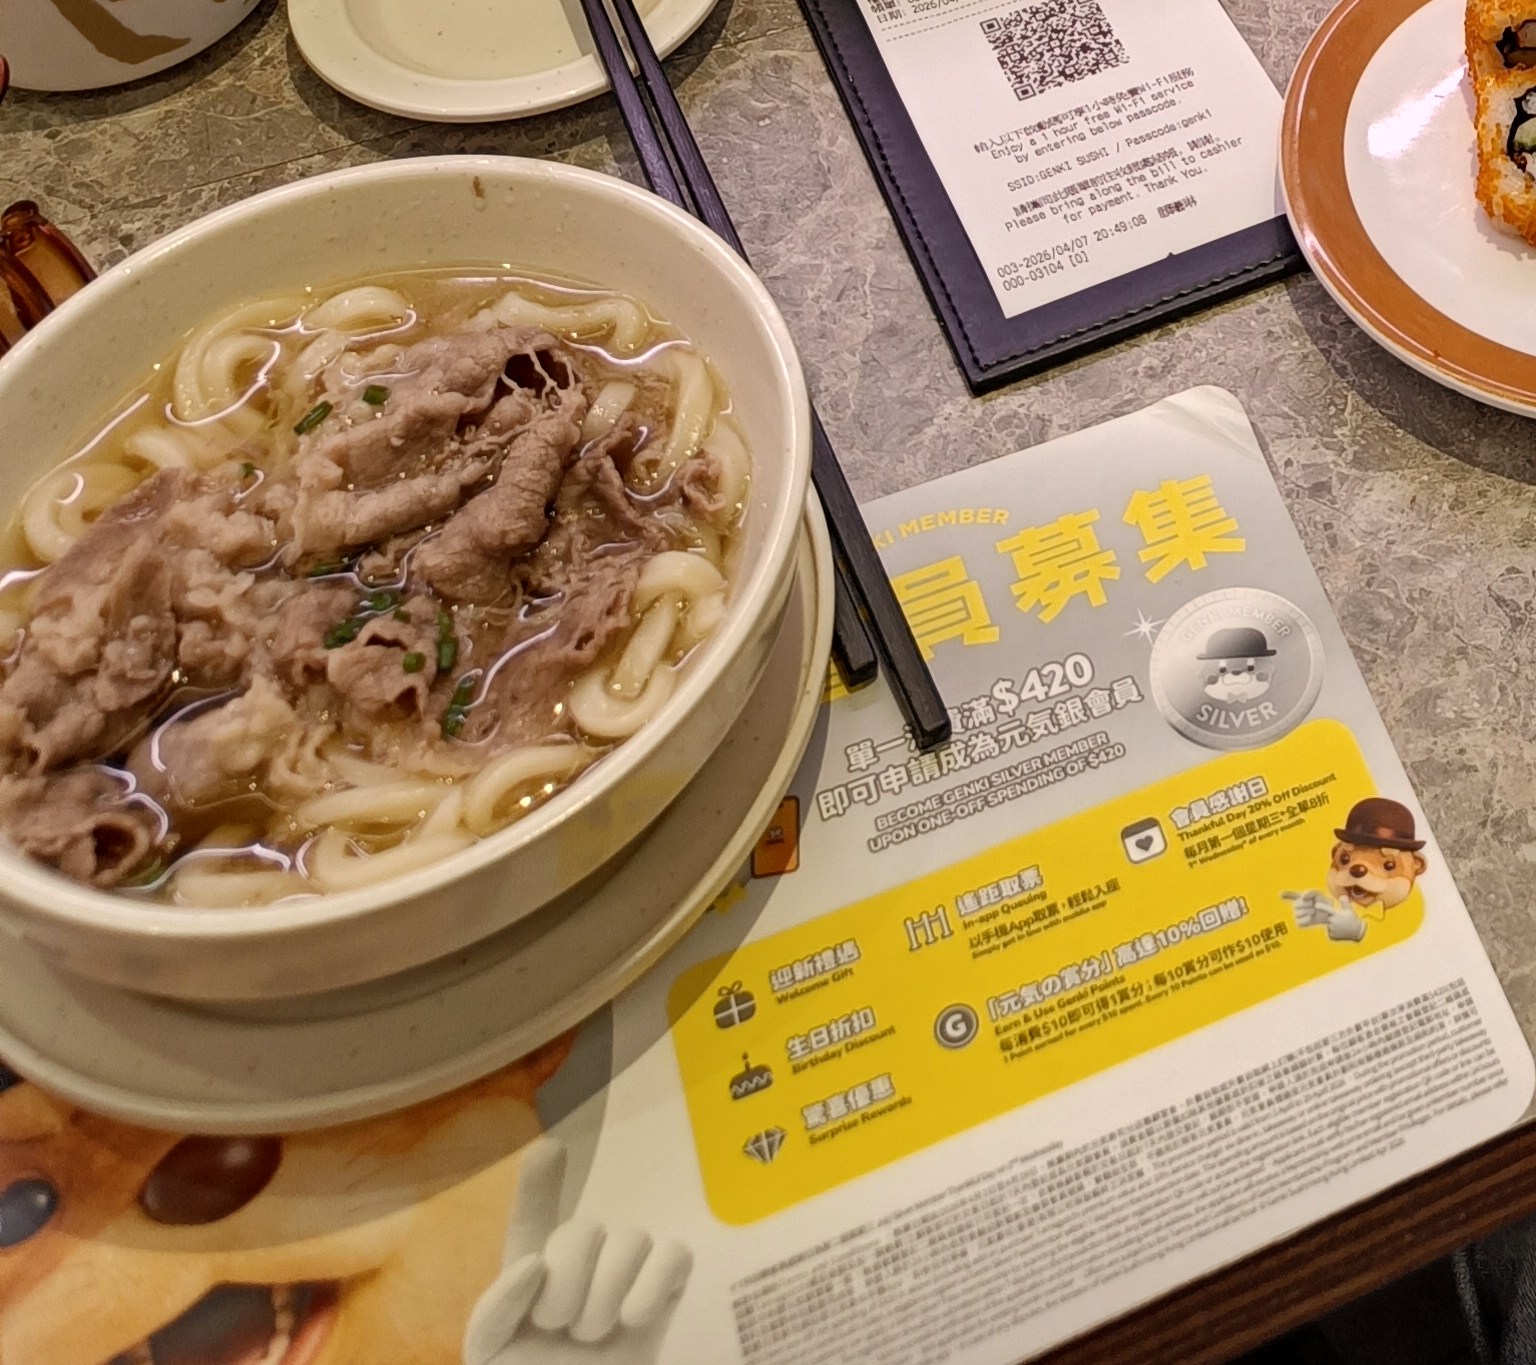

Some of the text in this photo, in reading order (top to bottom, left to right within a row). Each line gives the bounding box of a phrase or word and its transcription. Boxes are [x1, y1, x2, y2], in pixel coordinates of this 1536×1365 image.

[1050, 79, 1195, 137] hour free service
[1013, 116, 1123, 164] by below
[1003, 153, 1197, 233] Please bring along the to
[1005, 159, 1074, 192] SSID:GENKI
[1074, 146, 1111, 167] SUSHI
[1061, 173, 1179, 224] for Thank
[995, 234, 1091, 279] 003-2026/04/07
[1001, 259, 1066, 292] 000-03104
[901, 508, 1010, 539] MEMBER
[845, 652, 1094, 773] 單一滿$420
[1196, 701, 1279, 731] SILVER
[817, 676, 1144, 821] 即可申請成為元気銀會員
[865, 741, 1127, 854] UPON ONE-OFF SPENDING OF $420
[873, 729, 1110, 831] BECOME GENKI SILVER MEMBER
[1167, 774, 1270, 831] 會員感謝日
[1176, 771, 1337, 842] Thankful Day 20% Off Discount
[775, 965, 854, 1006] Welcome Gift
[1055, 972, 1126, 1010] Genki Points
[784, 1004, 877, 1062] 生日折扣
[791, 1023, 896, 1076] Birthday Discount
